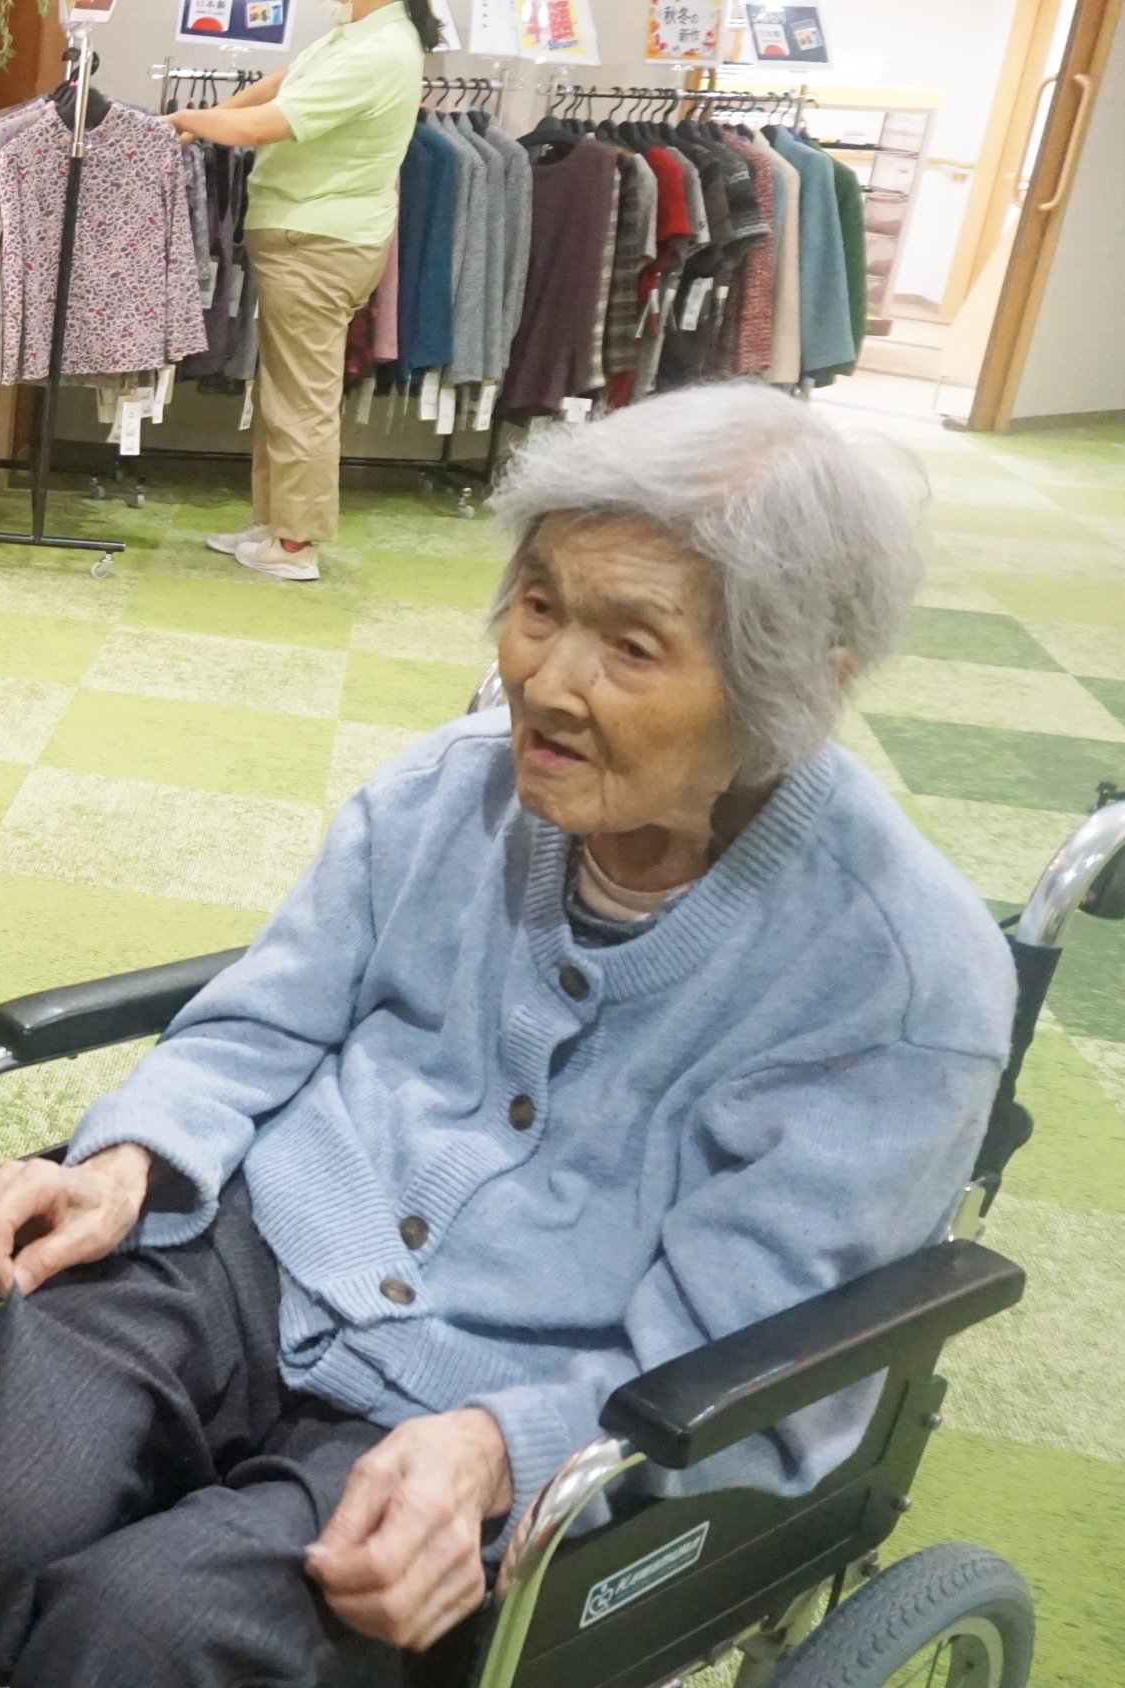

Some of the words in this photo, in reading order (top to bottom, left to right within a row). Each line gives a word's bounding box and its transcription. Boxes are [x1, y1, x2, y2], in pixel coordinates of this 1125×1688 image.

[663, 6, 699, 25] 秋冬の
[678, 28, 702, 42] 新作
